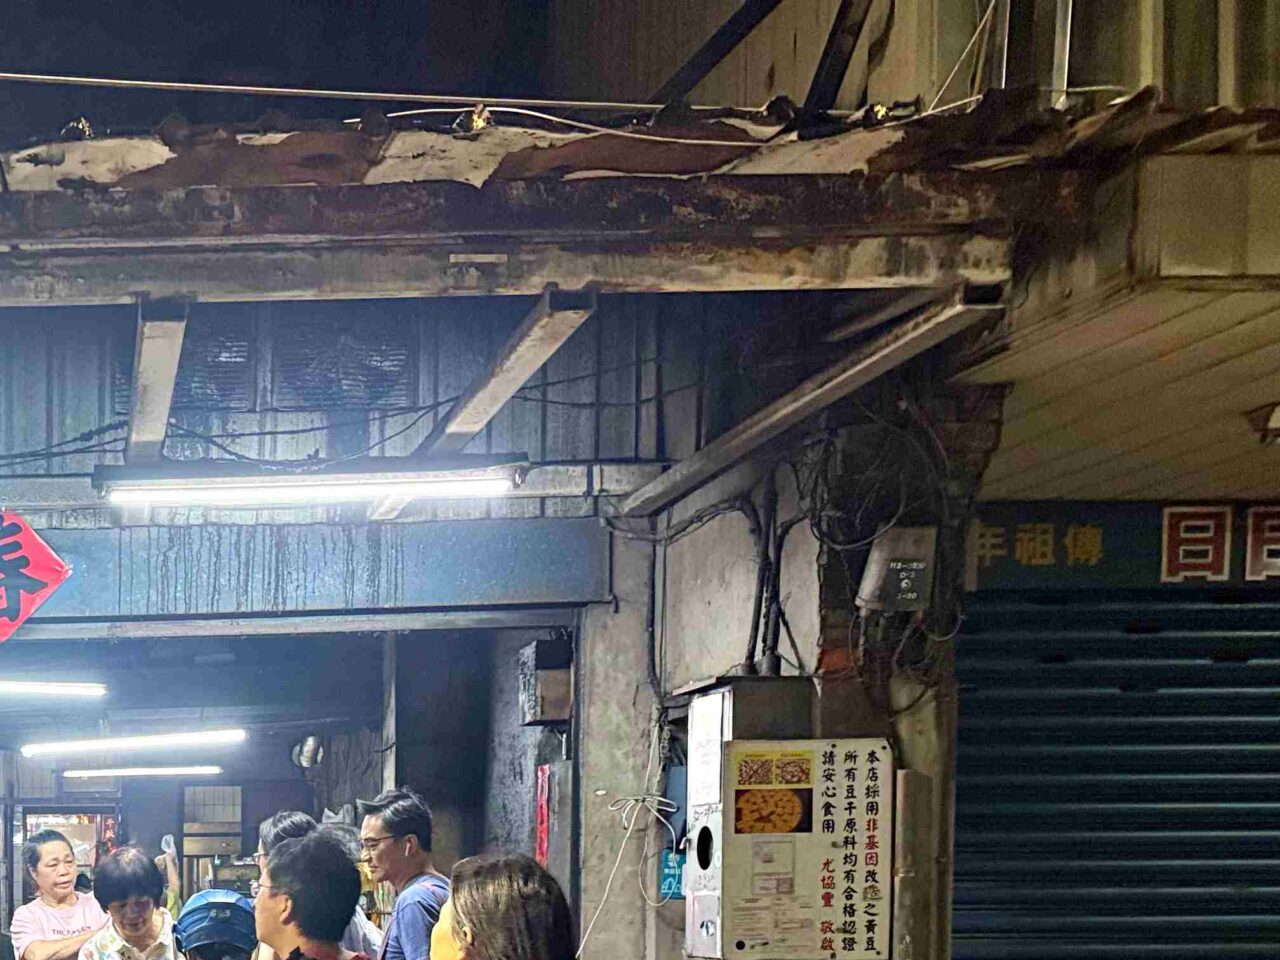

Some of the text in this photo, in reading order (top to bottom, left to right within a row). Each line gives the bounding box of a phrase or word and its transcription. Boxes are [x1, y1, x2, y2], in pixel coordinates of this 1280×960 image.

[821, 751, 837, 834] 請安心食用
[864, 750, 881, 952] 本店採用非基因改造之黃豆
